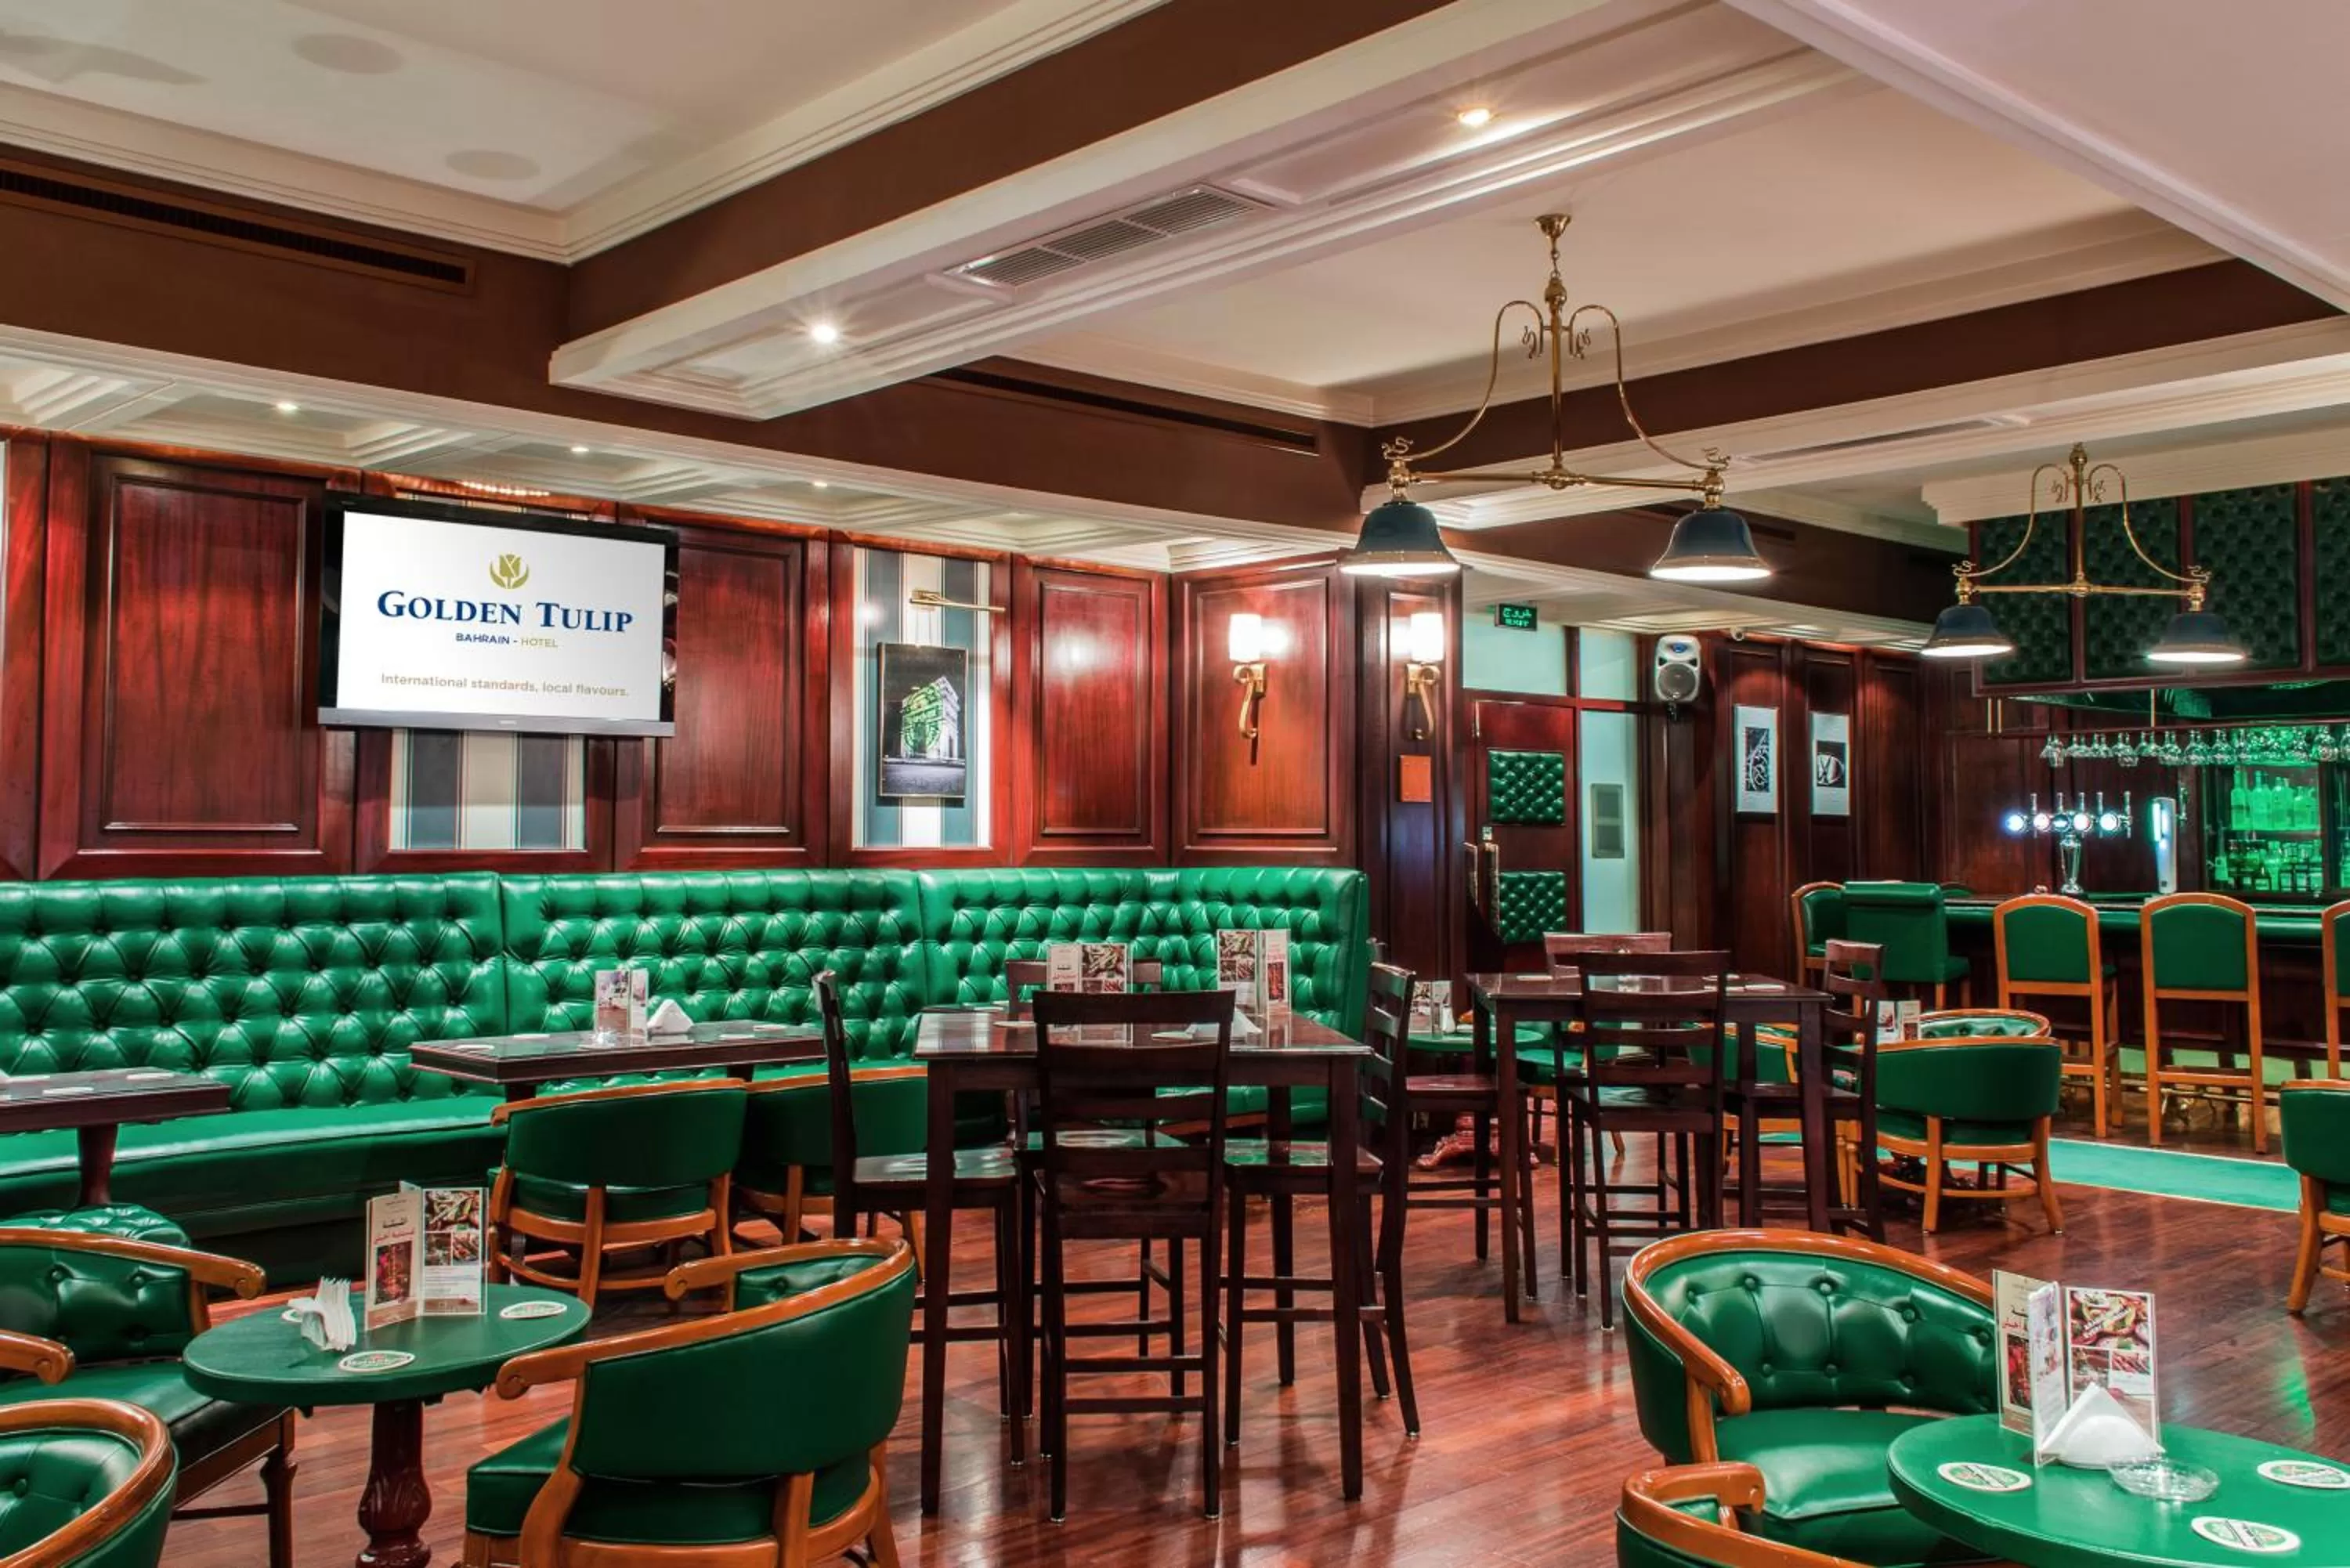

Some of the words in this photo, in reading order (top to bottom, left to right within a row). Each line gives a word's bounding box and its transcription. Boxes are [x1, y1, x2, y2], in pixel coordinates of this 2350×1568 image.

[377, 590, 522, 626] GOLDEN
[535, 602, 634, 633] TULIP
[455, 632, 511, 645] BAHRAIN
[521, 637, 559, 648] HOTEL
[381, 673, 468, 688] International
[471, 679, 538, 693] standards,
[542, 680, 573, 694] local
[576, 682, 630, 697] flavours.
